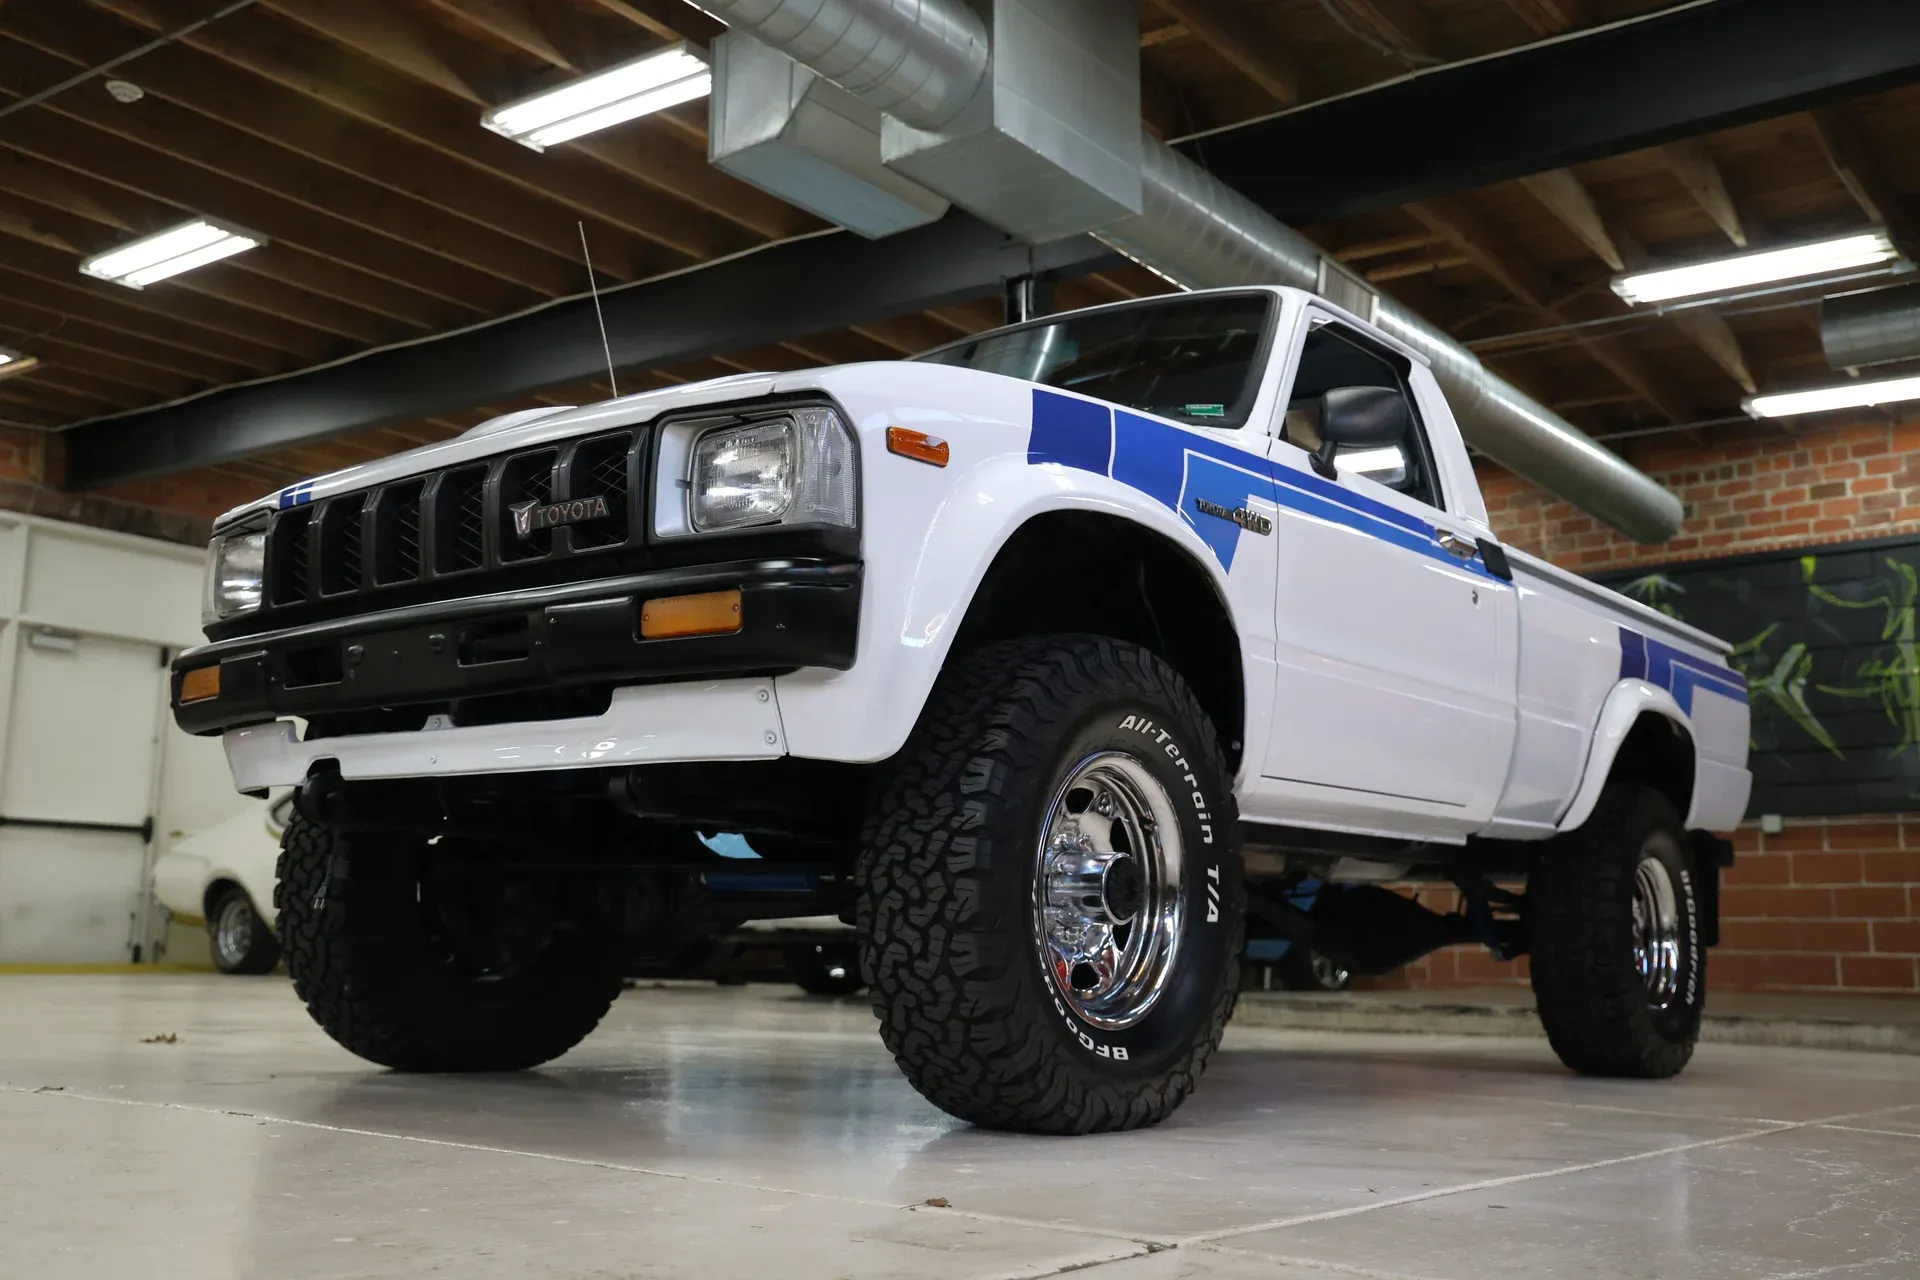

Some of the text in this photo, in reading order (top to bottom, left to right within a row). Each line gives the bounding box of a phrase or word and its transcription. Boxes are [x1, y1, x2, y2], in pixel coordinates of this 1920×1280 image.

[537, 497, 607, 527] TOYOTA
[1233, 507, 1272, 536] 4WD
[1118, 715, 1220, 923] All-Terrain T/A
